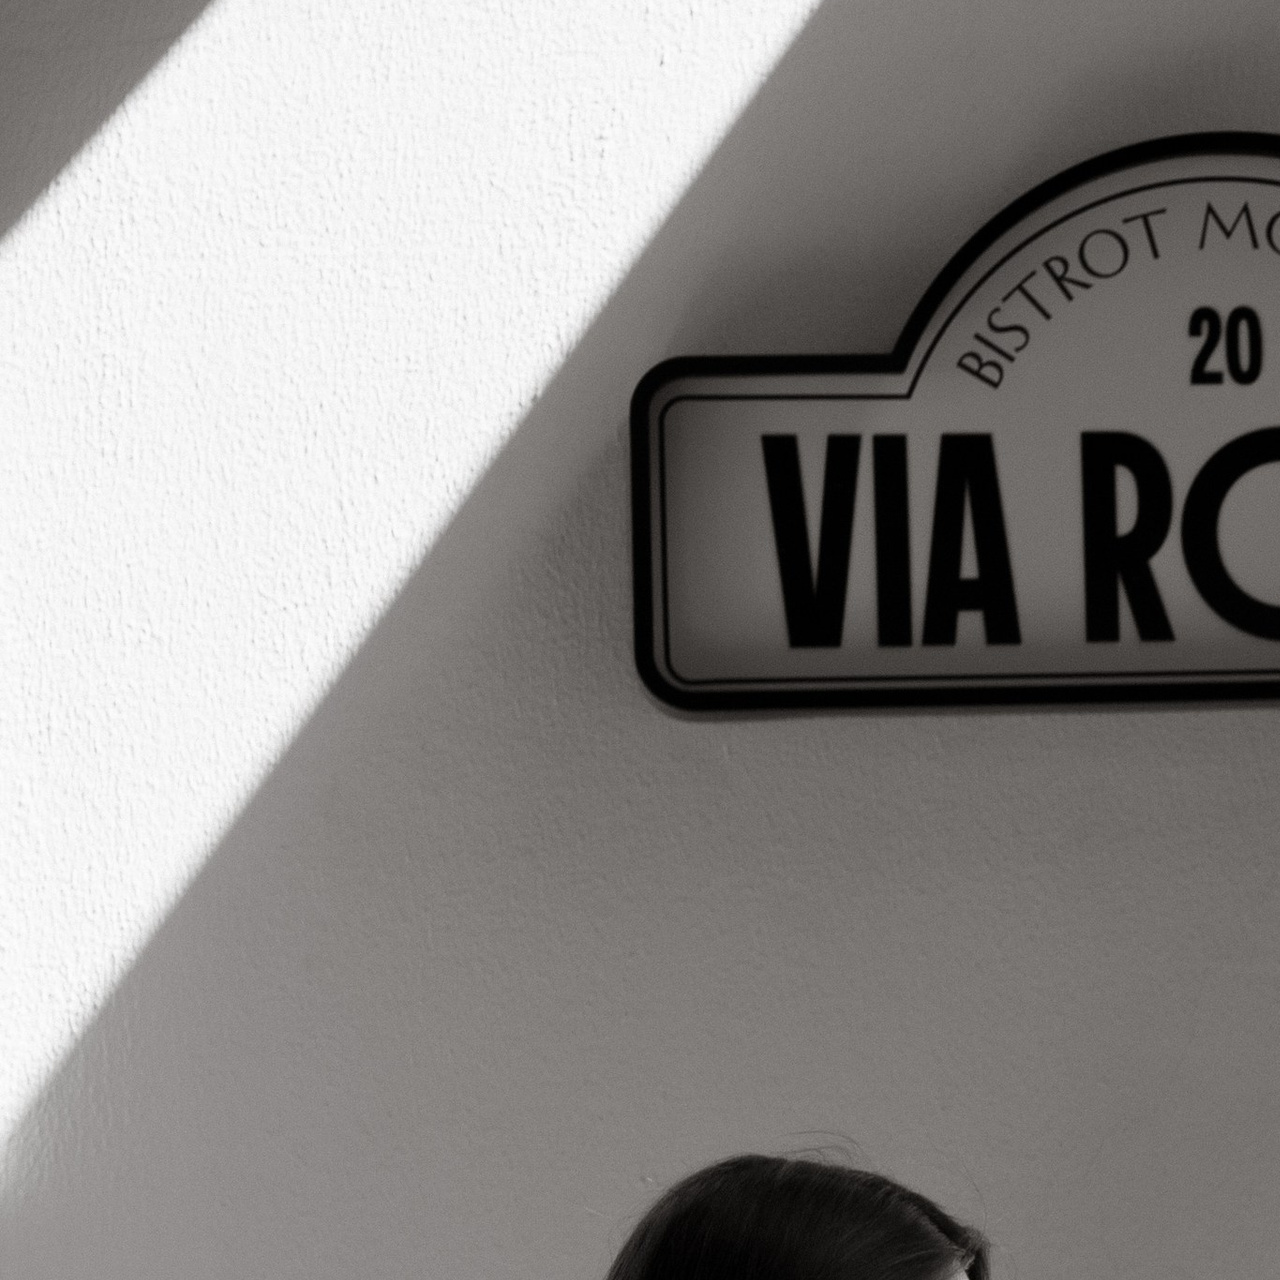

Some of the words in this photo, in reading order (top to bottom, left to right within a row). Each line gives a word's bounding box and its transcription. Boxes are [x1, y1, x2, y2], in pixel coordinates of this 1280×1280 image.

[956, 207, 1169, 389] BISTROT
[1187, 305, 1264, 386] 20
[760, 433, 1022, 649] VIA
